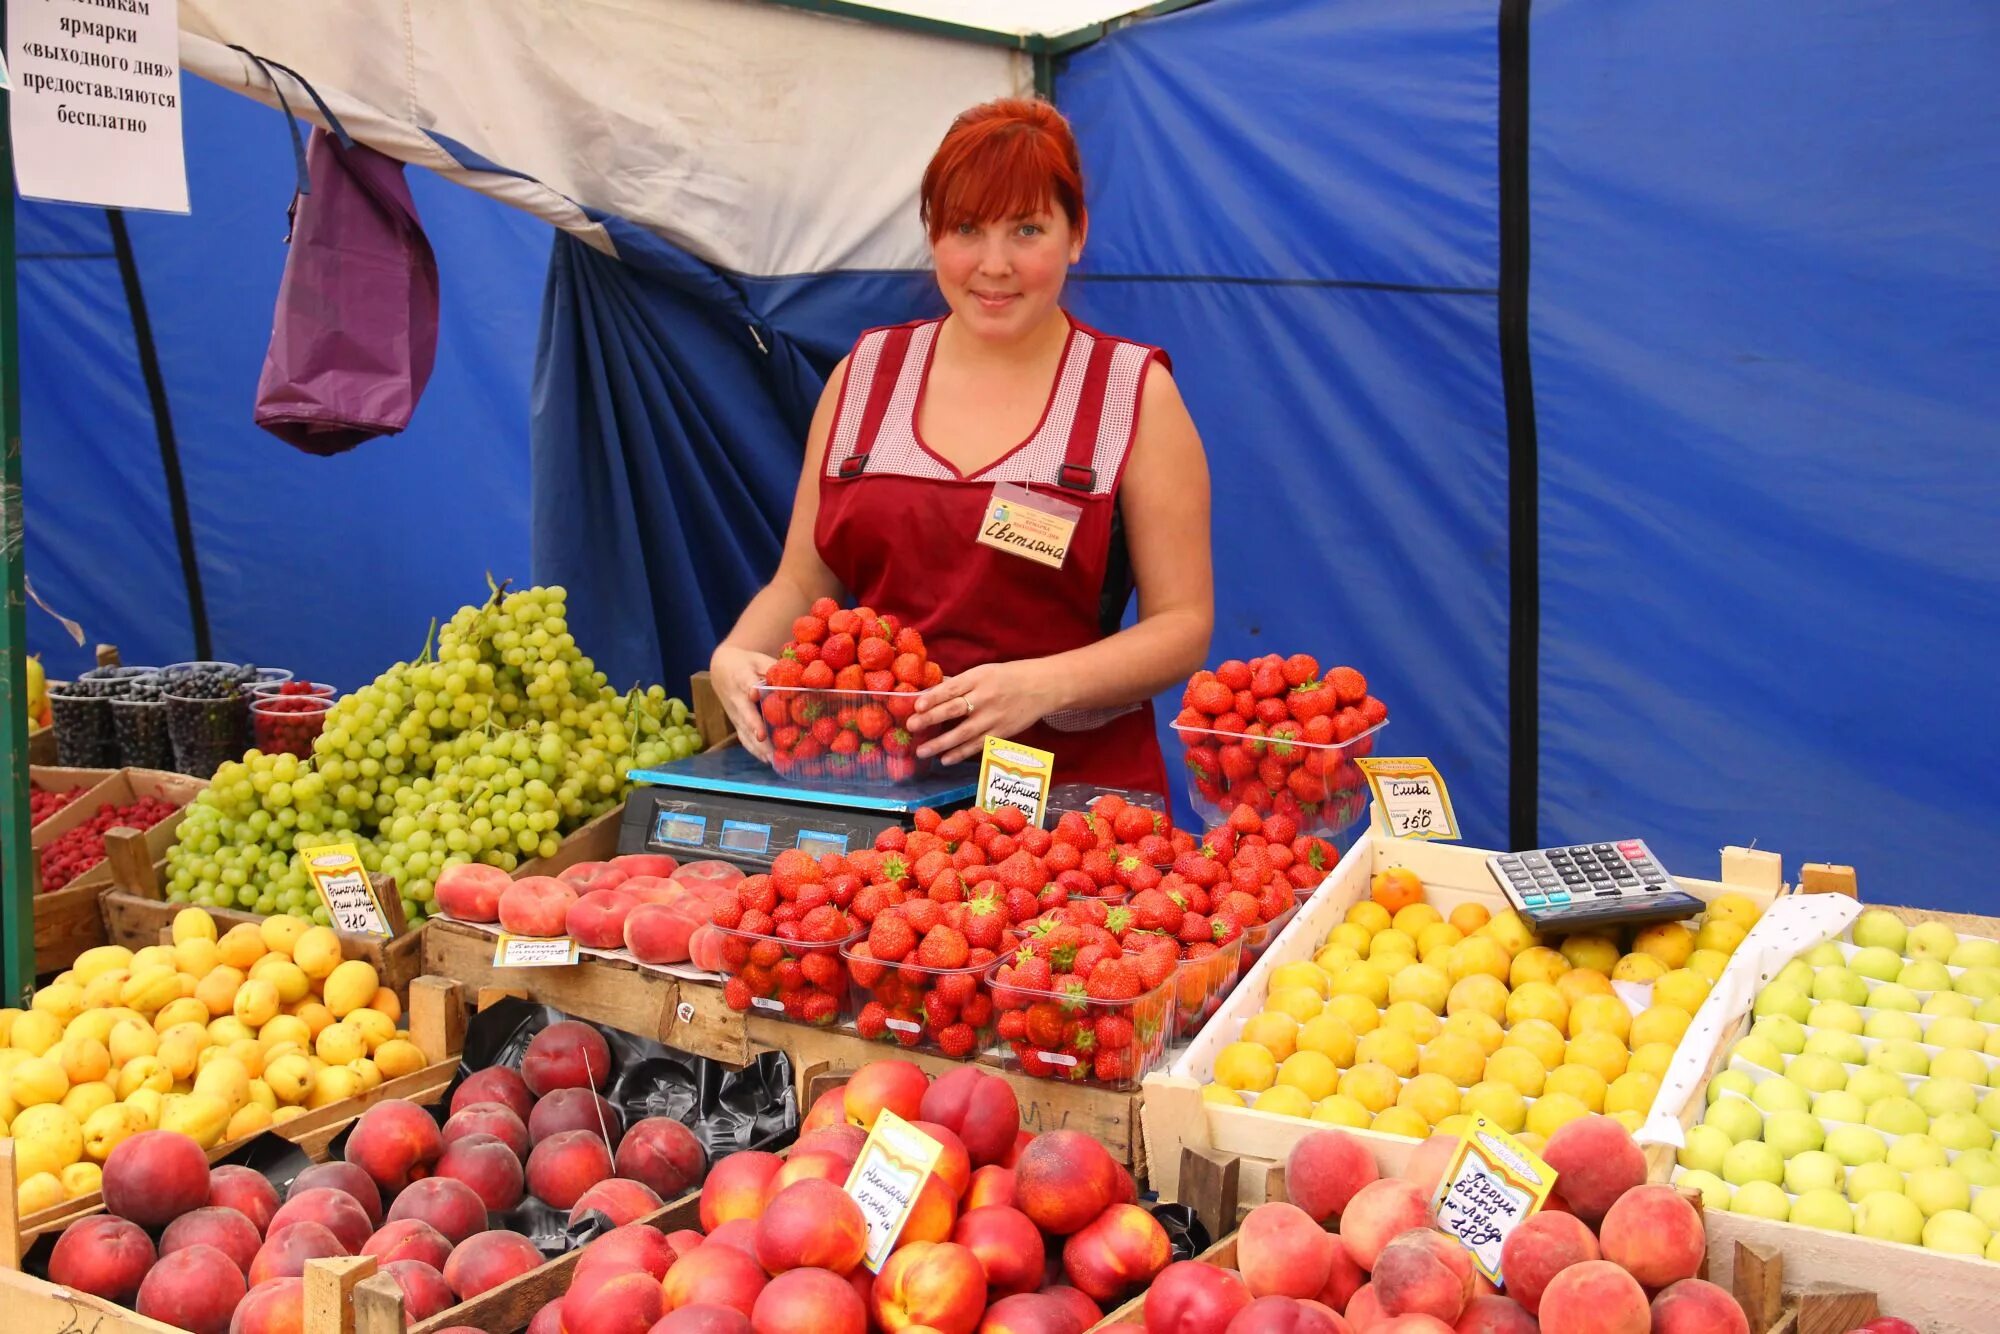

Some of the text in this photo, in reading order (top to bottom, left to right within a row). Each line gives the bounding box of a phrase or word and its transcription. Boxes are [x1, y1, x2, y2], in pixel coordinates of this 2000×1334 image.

[45, 0, 149, 15] никам
[60, 16, 137, 43] ярмарки
[23, 41, 173, 79] «выходного дня»
[23, 72, 176, 108] предоставляются
[57, 104, 148, 133] бесплатно
[985, 521, 1064, 560] Светлана
[1393, 783, 1431, 796] Слива
[1402, 815, 1431, 829] 150
[344, 914, 367, 929] 180
[1466, 1172, 1517, 1217] Персик
[1451, 1218, 1492, 1245] 180
